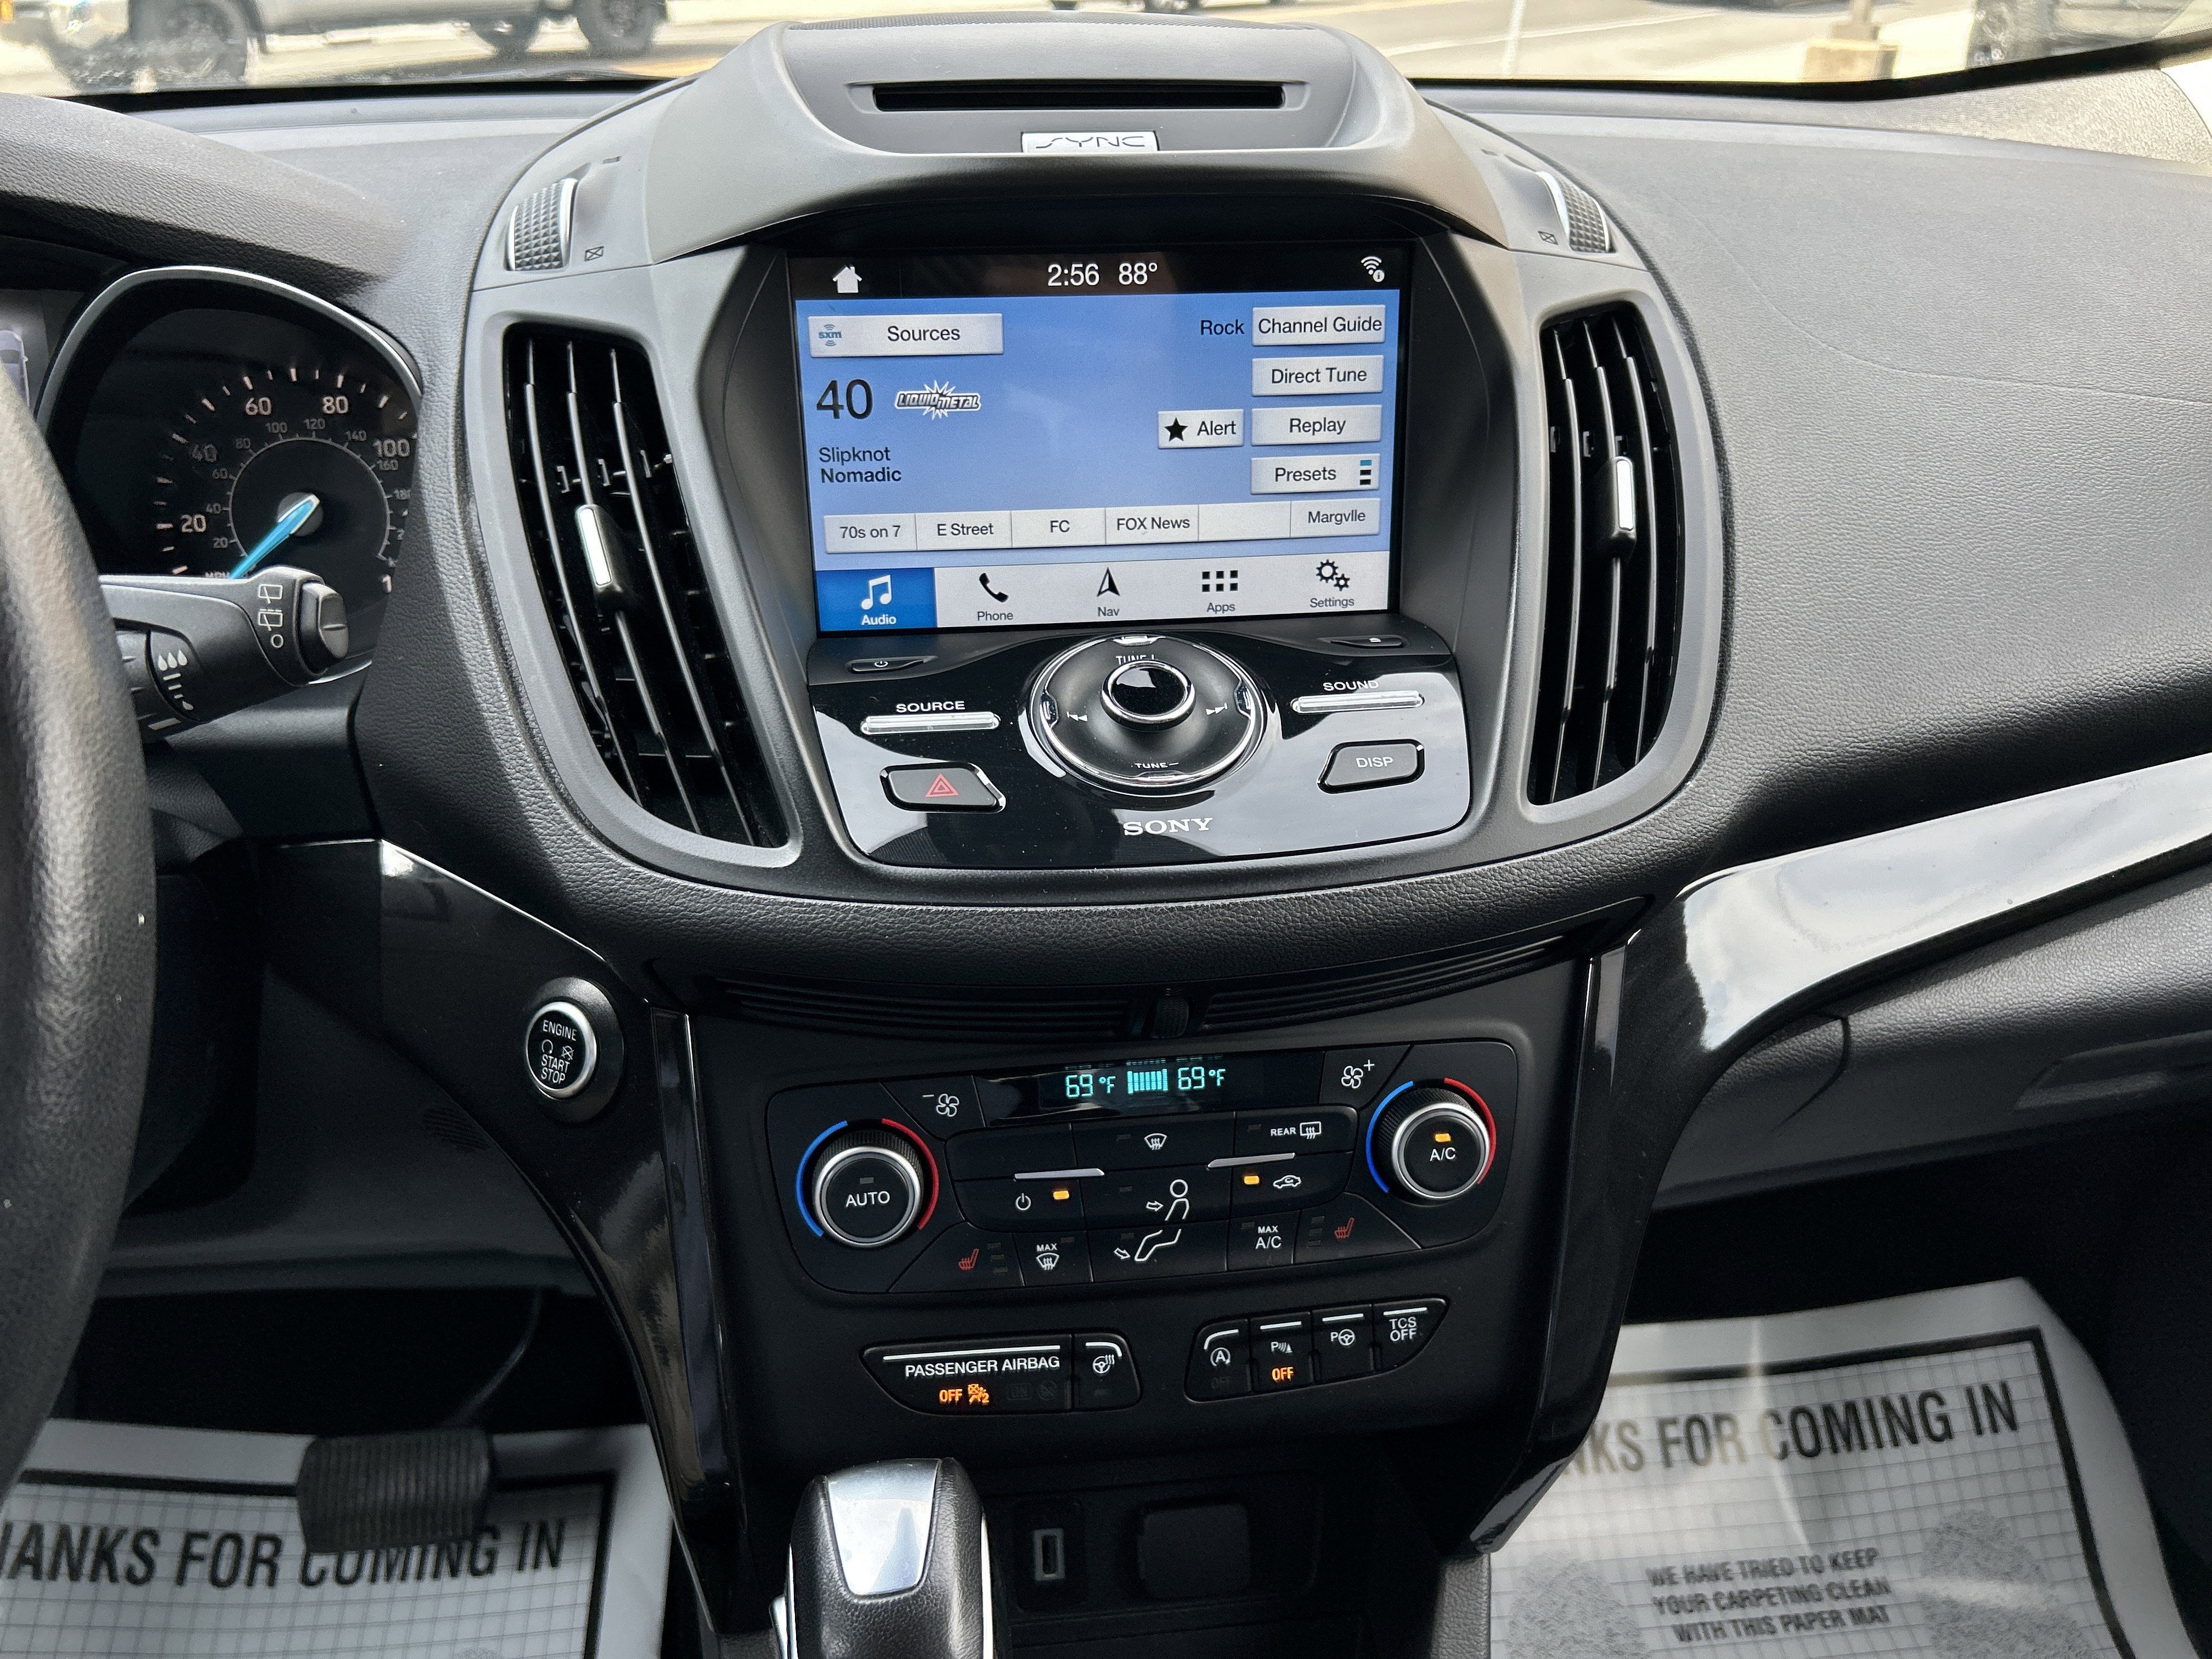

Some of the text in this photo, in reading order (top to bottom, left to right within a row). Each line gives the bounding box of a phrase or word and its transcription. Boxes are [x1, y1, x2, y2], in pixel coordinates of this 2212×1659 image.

[1036, 135, 1145, 149] SYNC
[1047, 263, 1099, 287] 2:56
[1119, 262, 1158, 285] 88°
[1200, 319, 1245, 335] Rock
[1258, 316, 1383, 335] Channel Guide
[887, 325, 961, 342] Sources
[1272, 367, 1368, 385] Direct Tune
[245, 396, 272, 416] 60
[322, 396, 349, 415] 80
[817, 379, 873, 420] 40
[265, 422, 288, 433] 100
[303, 418, 326, 430] 120
[1197, 420, 1237, 436] Alert
[1290, 417, 1346, 435] Replay
[235, 437, 251, 449] 80
[344, 430, 368, 442] 140
[190, 443, 218, 463] 40
[373, 439, 411, 458] 100
[819, 447, 891, 466] Slipknot
[212, 467, 228, 479] 60
[821, 467, 902, 483] Nomadic
[1275, 466, 1337, 483] Presets
[205, 504, 221, 515] 40
[179, 514, 207, 533] 20
[1116, 516, 1190, 531] FOX News
[1308, 510, 1366, 526] Margvlle
[839, 525, 901, 540] 70s on 7
[937, 522, 995, 537] E Street
[1051, 520, 1070, 533] FC
[212, 537, 228, 549] 20
[1206, 602, 1236, 614] Apps
[1310, 596, 1355, 610] Settings
[977, 610, 1014, 622] Phone
[1098, 606, 1120, 617] Nav
[861, 614, 897, 626] Audio
[1323, 680, 1380, 691] SOUND
[896, 701, 966, 713] SOURCE
[1356, 757, 1393, 769] DISP
[1123, 818, 1213, 836] SONY
[543, 1020, 578, 1041] ENGINE
[541, 1054, 570, 1073] START
[541, 1066, 566, 1085] STOP
[1270, 1127, 1296, 1137] REAR
[1430, 1147, 1456, 1162] A/C
[845, 1190, 890, 1208] AUTO
[1257, 1225, 1278, 1234] MAX
[1036, 1243, 1057, 1252] MAX
[1255, 1235, 1282, 1250] A/C
[1389, 1317, 1417, 1330] TCS
[1390, 1328, 1417, 1342] OFF
[905, 1356, 1060, 1378] PASSENGER AIRBAG
[1272, 1367, 1294, 1382] OFF
[939, 1389, 963, 1403] OFF
[1657, 1413, 1747, 1469] FOR
[1759, 1390, 1954, 1462] COMING
[1966, 1381, 2019, 1436] IN
[176, 1532, 282, 1589] FOR
[299, 1525, 501, 1586] COMING
[517, 1520, 564, 1572] IN
[1646, 1547, 1878, 1587] WE HAVE TRIED TO KEEP
[1651, 1576, 1892, 1615] YOUR CARPETING CLEAN
[1672, 1605, 1891, 1643] WITH THIS PAPER MAT
